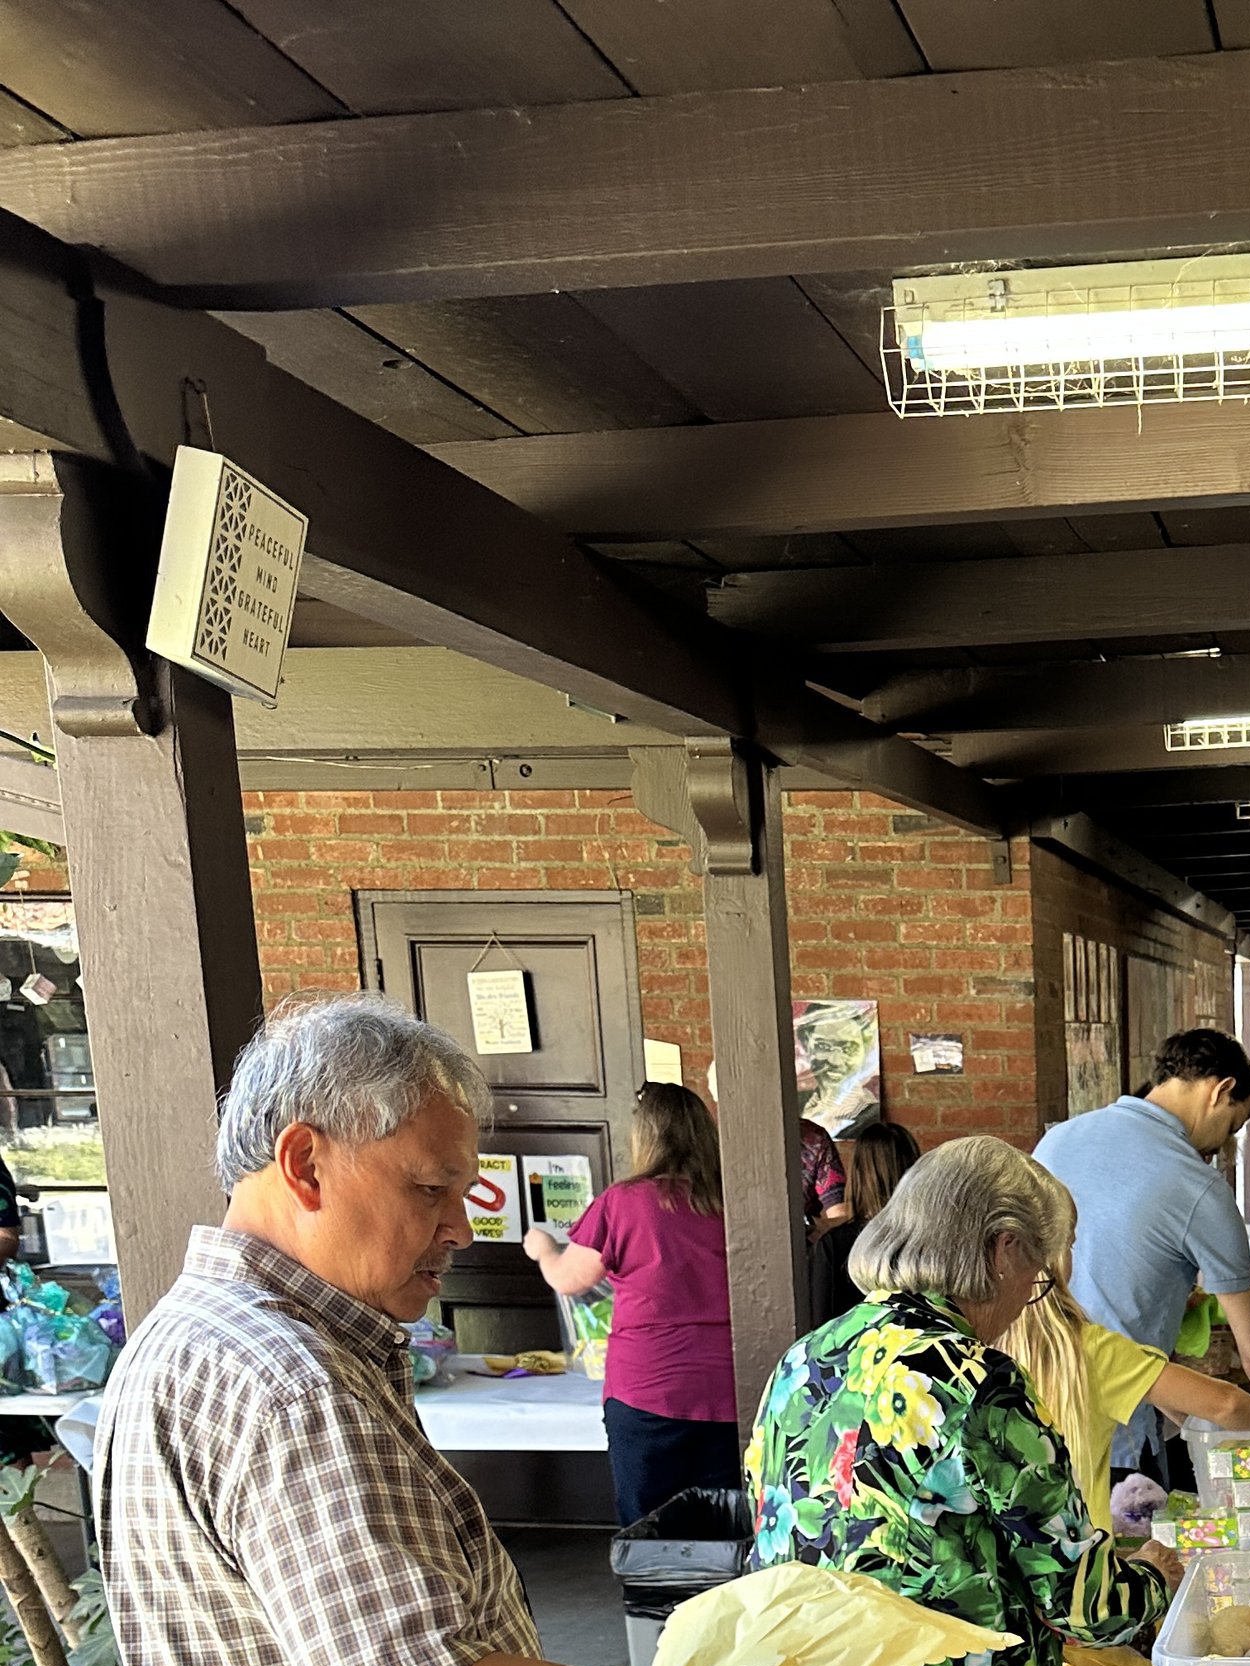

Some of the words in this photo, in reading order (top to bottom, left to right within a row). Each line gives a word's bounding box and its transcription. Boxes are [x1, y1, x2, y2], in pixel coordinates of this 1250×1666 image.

[248, 523, 294, 571] PEACEFUL
[256, 565, 278, 593] MIND
[237, 589, 284, 634] GRATEFUL
[242, 627, 271, 657] HEART
[480, 1160, 506, 1170] RACT
[473, 1216, 503, 1226] GOOD
[552, 1218, 574, 1229] Tod
